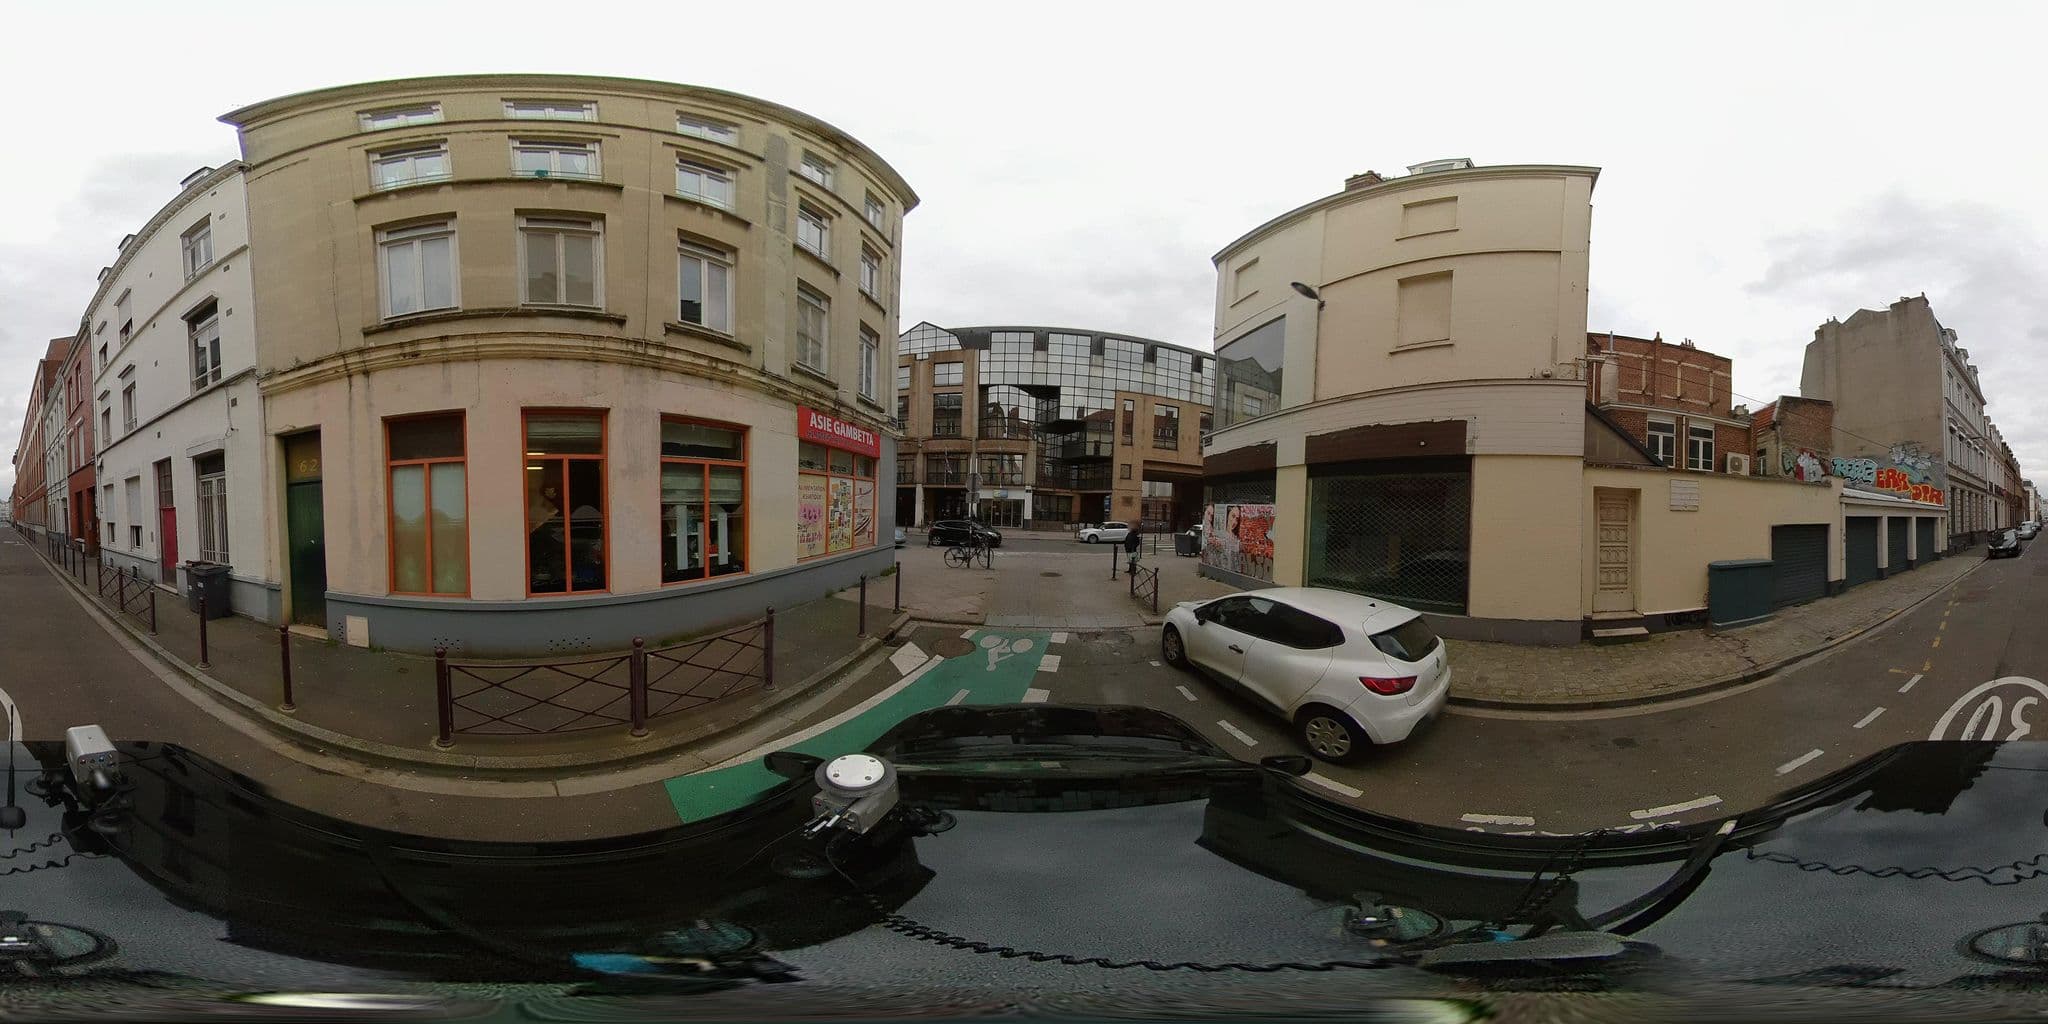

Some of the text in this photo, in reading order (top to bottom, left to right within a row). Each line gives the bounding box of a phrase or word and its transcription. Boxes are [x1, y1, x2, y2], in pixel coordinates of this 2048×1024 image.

[810, 412, 832, 432] ASIE
[833, 421, 874, 446] GAMBETTA
[299, 458, 318, 473] 62
